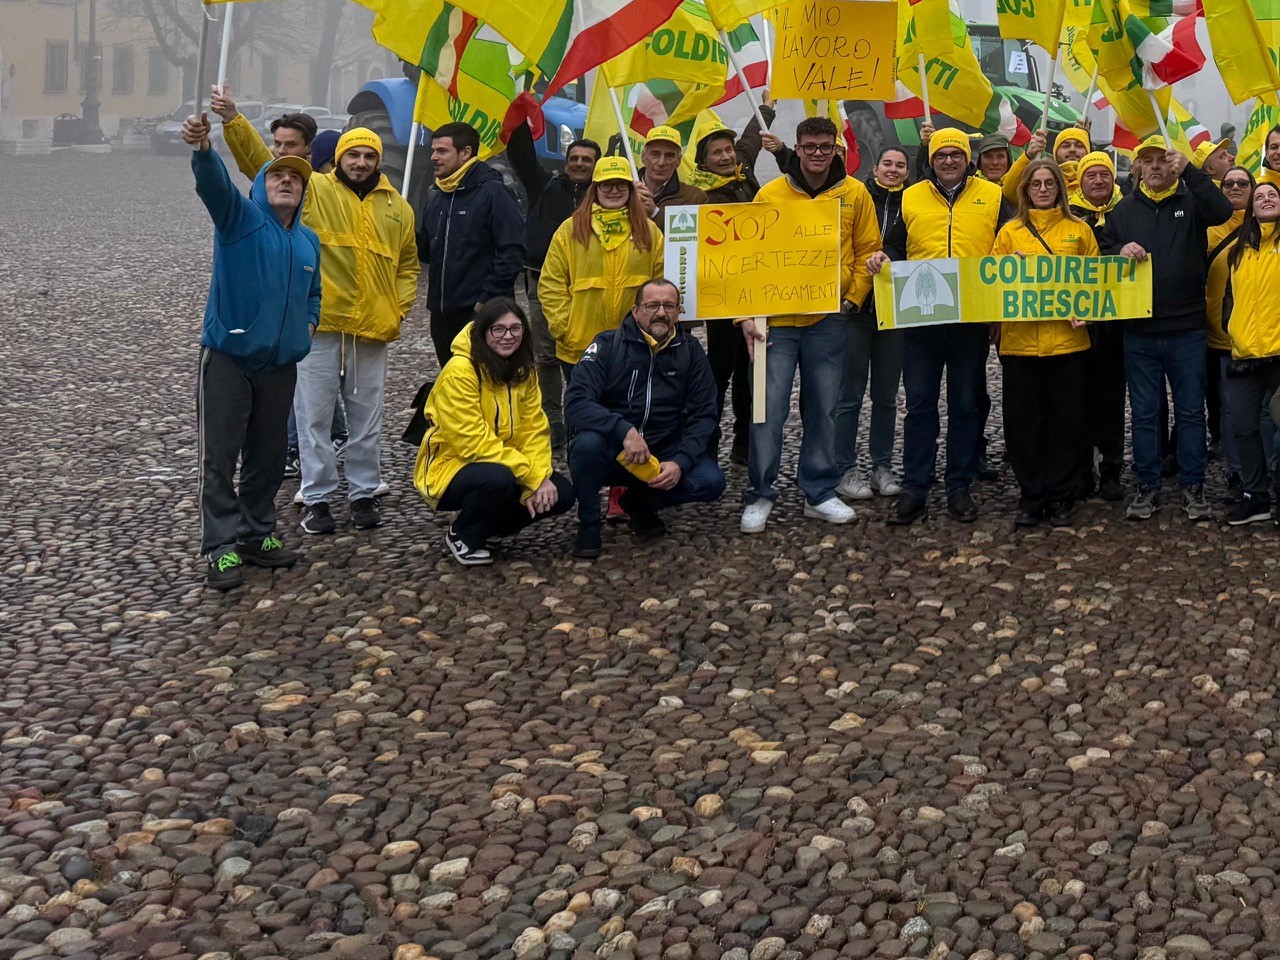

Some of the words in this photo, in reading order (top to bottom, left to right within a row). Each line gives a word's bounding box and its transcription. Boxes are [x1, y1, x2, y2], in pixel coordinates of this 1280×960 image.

[783, 7, 793, 30] IL
[801, 2, 840, 29] MIO
[783, 34, 871, 59] LAVORO
[794, 58, 879, 91] VALE!
[705, 209, 779, 246] STOP
[793, 225, 833, 238] ALLE
[703, 249, 838, 279] INCERTEZZE
[979, 255, 1137, 286] COLDIRETTI
[738, 288, 752, 306] AI
[761, 281, 838, 303] PAGAMENTI
[1003, 289, 1118, 319] BRESCIA
